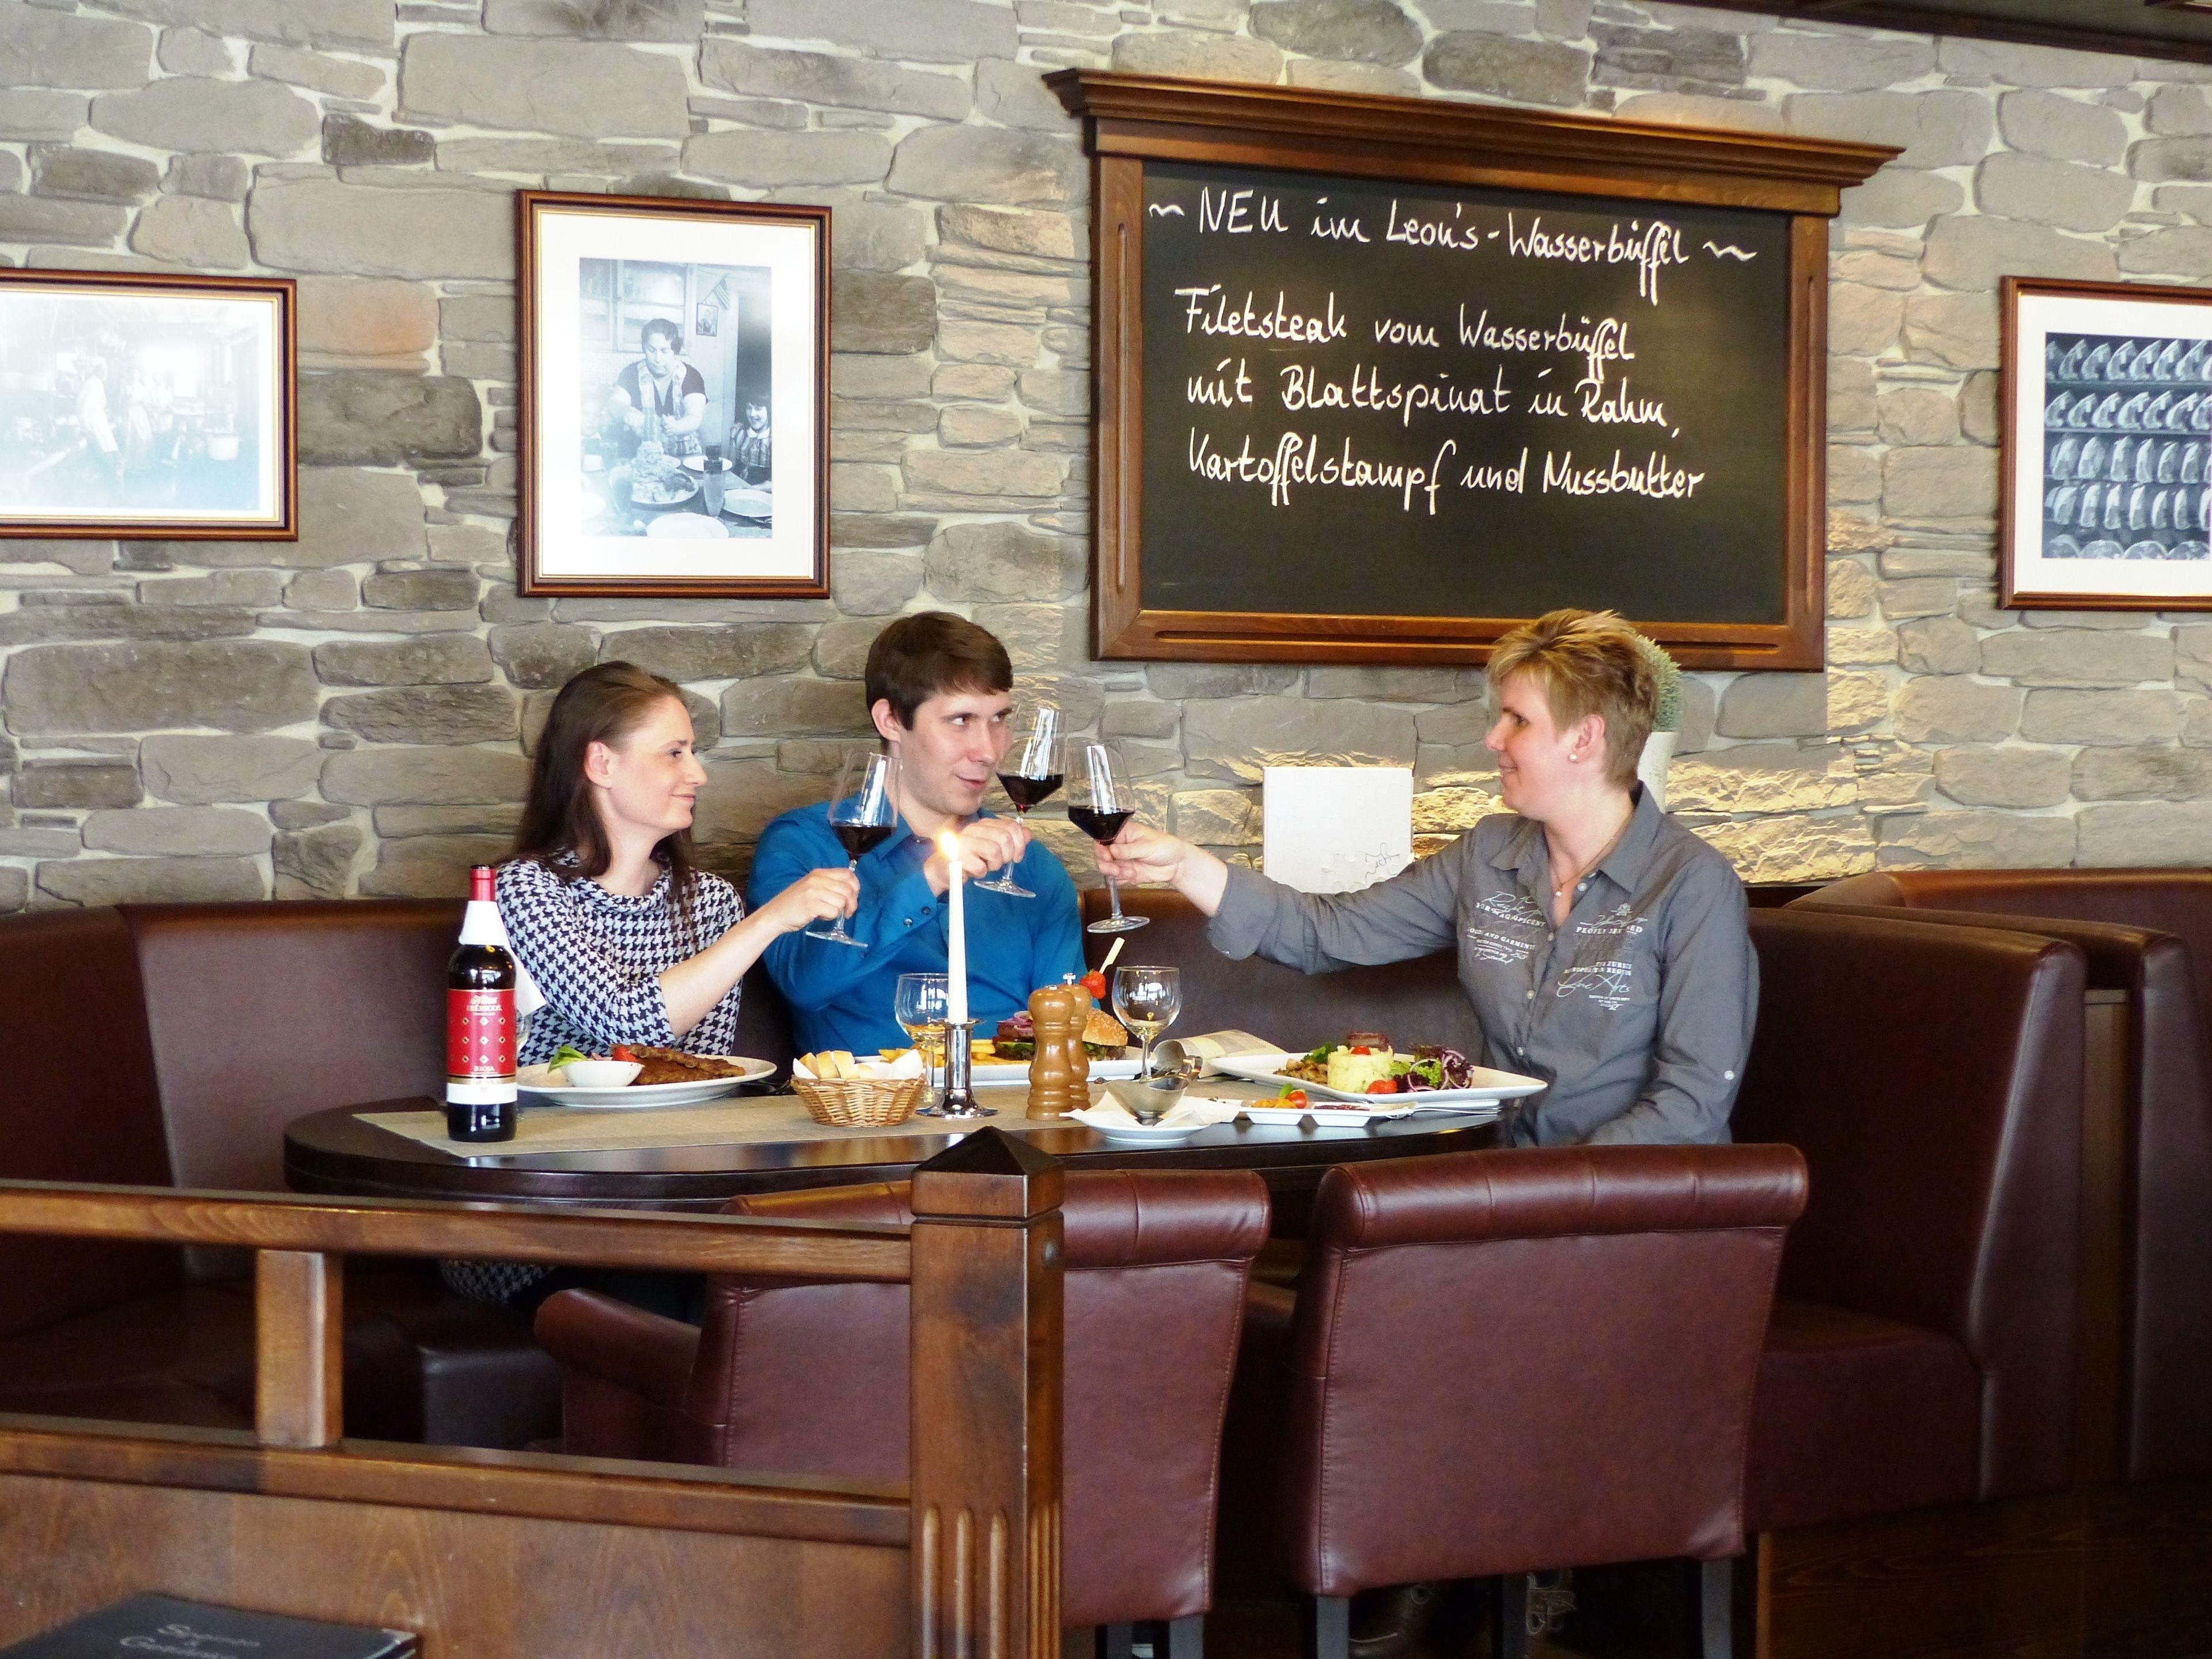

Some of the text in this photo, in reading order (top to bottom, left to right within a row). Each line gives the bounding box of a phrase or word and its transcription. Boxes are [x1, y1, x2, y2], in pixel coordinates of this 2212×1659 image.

[1199, 186, 1289, 233] NEU
[1310, 197, 1371, 243] im
[1174, 284, 1635, 381] Filetsteak vom Wasserbüffel
[1187, 358, 1680, 438] mit Blattspinat in Rahm,
[1189, 427, 1705, 516] Kartoffelstampf und Nussbutter
